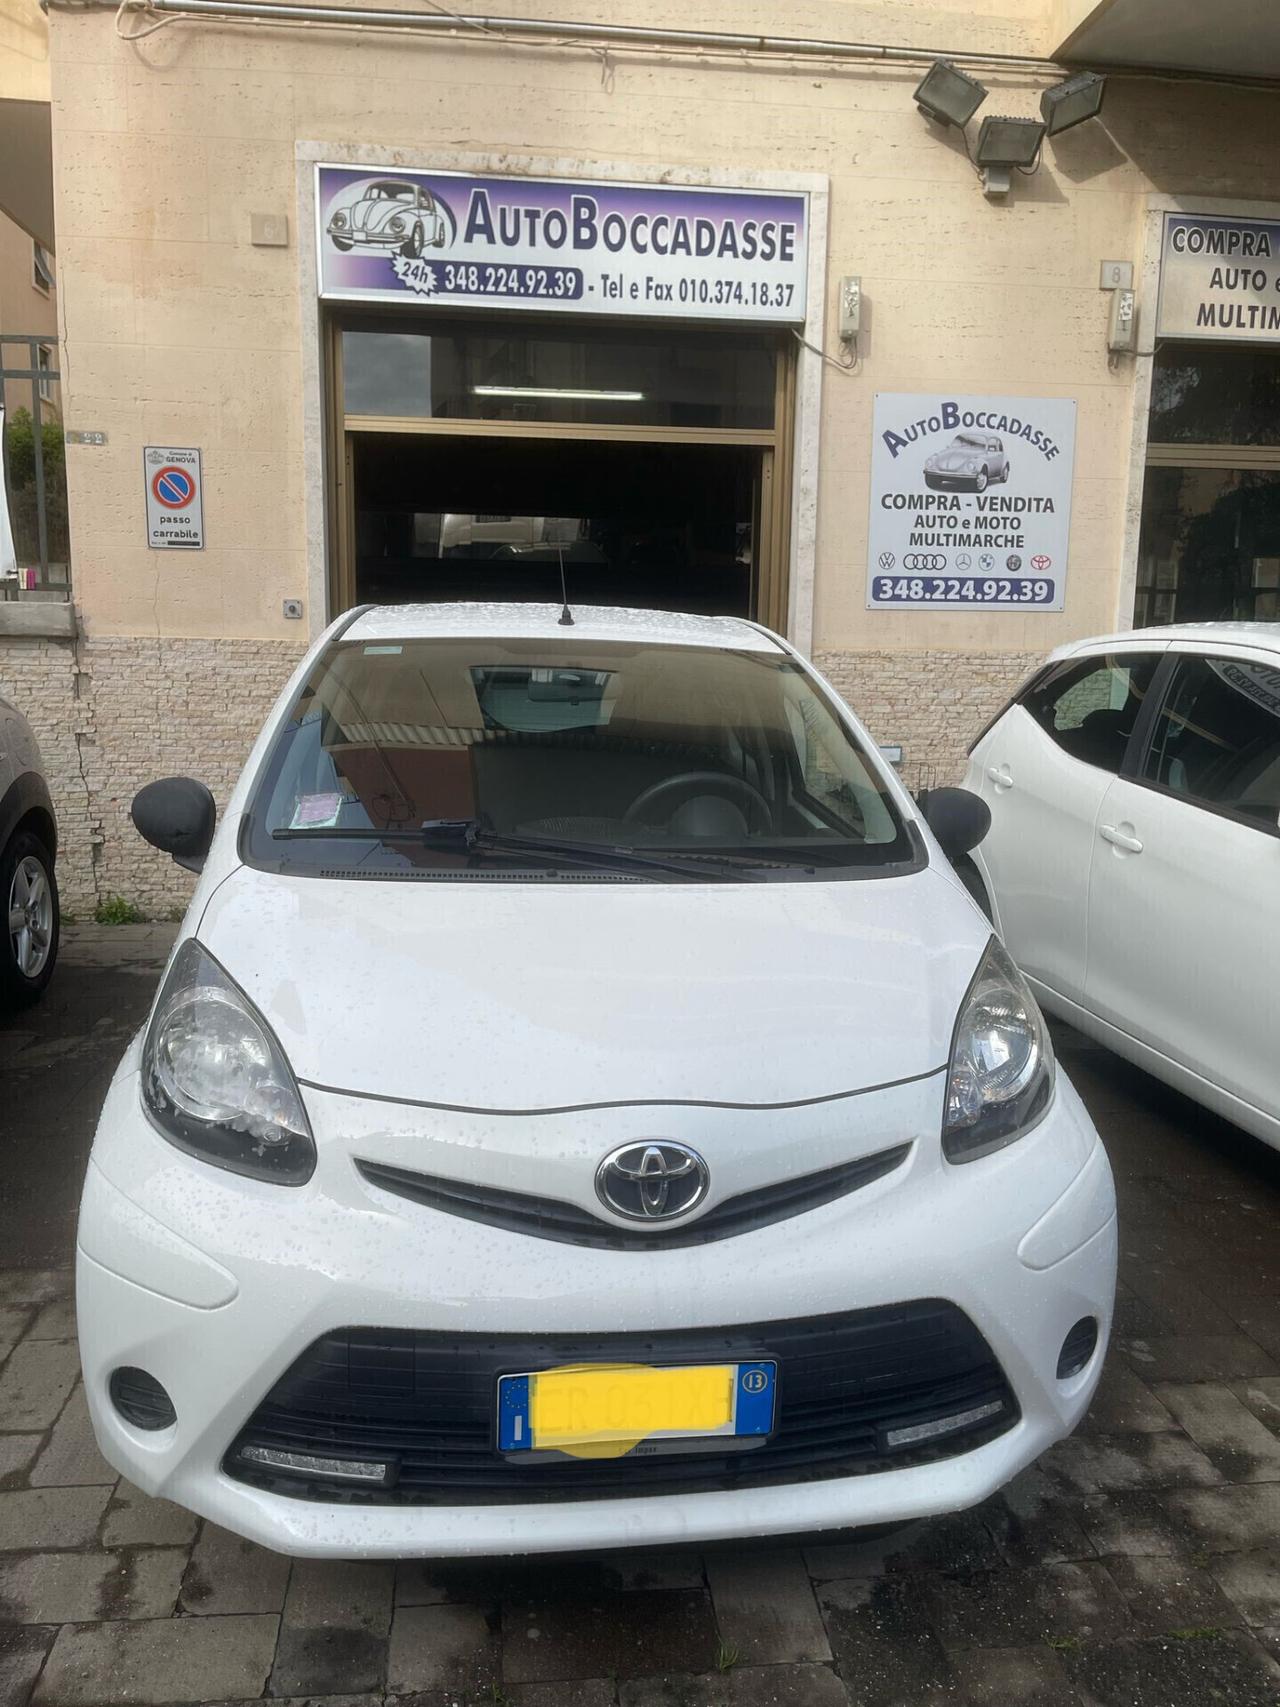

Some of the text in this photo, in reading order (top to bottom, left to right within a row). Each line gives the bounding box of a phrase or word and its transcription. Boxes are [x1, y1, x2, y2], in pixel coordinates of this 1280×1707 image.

[1172, 227, 1272, 258] COMPRA
[401, 262, 429, 284] 24h
[444, 264, 577, 296] 348.224.92.39
[601, 273, 623, 299] Tel
[630, 281, 640, 300] e
[645, 276, 673, 301] Fax
[679, 277, 795, 307] 010.374.18.37
[1209, 267, 1267, 292] AUTO
[881, 493, 961, 511] COMPRA
[976, 495, 1055, 513] VENDITA
[160, 516, 191, 525] passo
[914, 514, 1022, 530] AUTO e MOTO
[153, 529, 199, 538] carrabile
[909, 532, 1025, 548] MULTIMARCHE
[879, 579, 1049, 601] 348.224.92.39
[748, 1374, 763, 1389] 13
